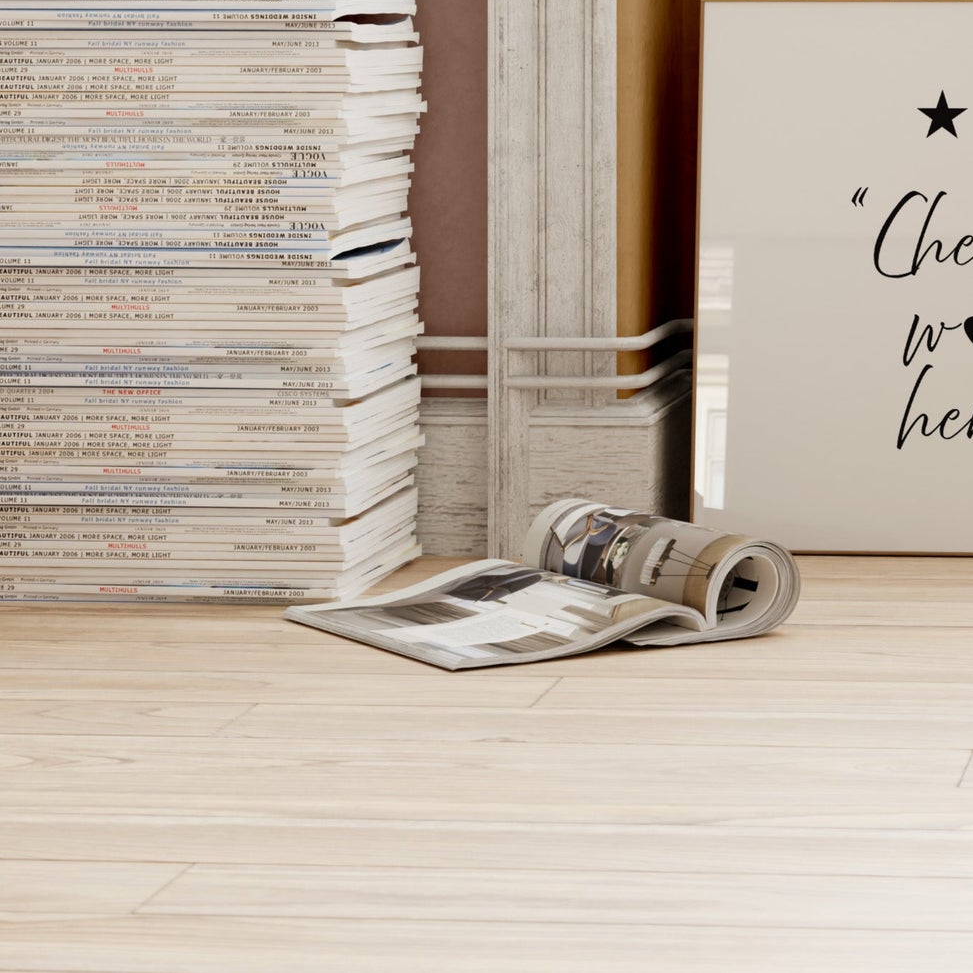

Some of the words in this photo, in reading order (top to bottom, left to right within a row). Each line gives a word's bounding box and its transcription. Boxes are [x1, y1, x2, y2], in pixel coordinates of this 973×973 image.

[290, 152, 326, 160] VOGUE
[292, 170, 327, 178] VOGUE
[290, 222, 325, 230] VOGUE
